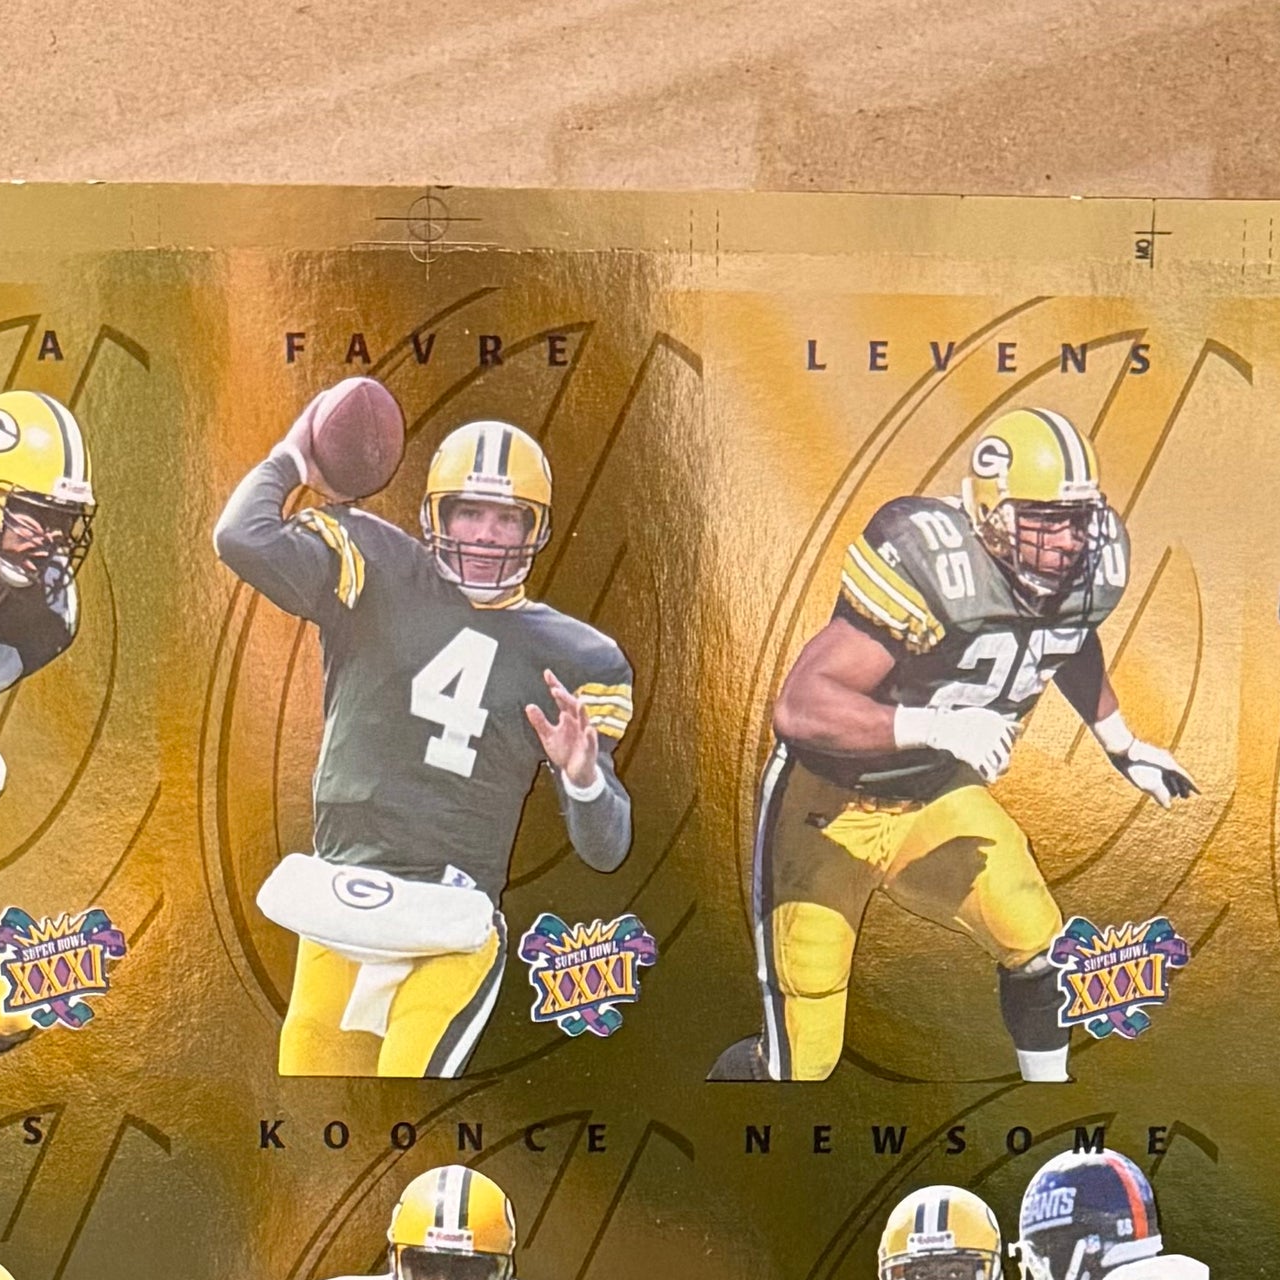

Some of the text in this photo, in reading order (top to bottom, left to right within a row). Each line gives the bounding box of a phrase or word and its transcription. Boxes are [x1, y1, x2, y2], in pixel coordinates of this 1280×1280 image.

[286, 333, 570, 367] FAVRE
[808, 339, 1152, 375] LEVENS
[411, 627, 498, 778] 4
[23, 934, 87, 961] SUPER BOWL
[555, 941, 618, 969] SUPER BOWL
[1084, 943, 1149, 972] SUPER BOWL
[7, 945, 105, 1006] XXXI
[539, 952, 636, 1014] XXXI
[1067, 954, 1164, 1017] XXXI
[259, 1119, 608, 1154] KOONCE
[744, 1125, 1168, 1156] NEWSOME
